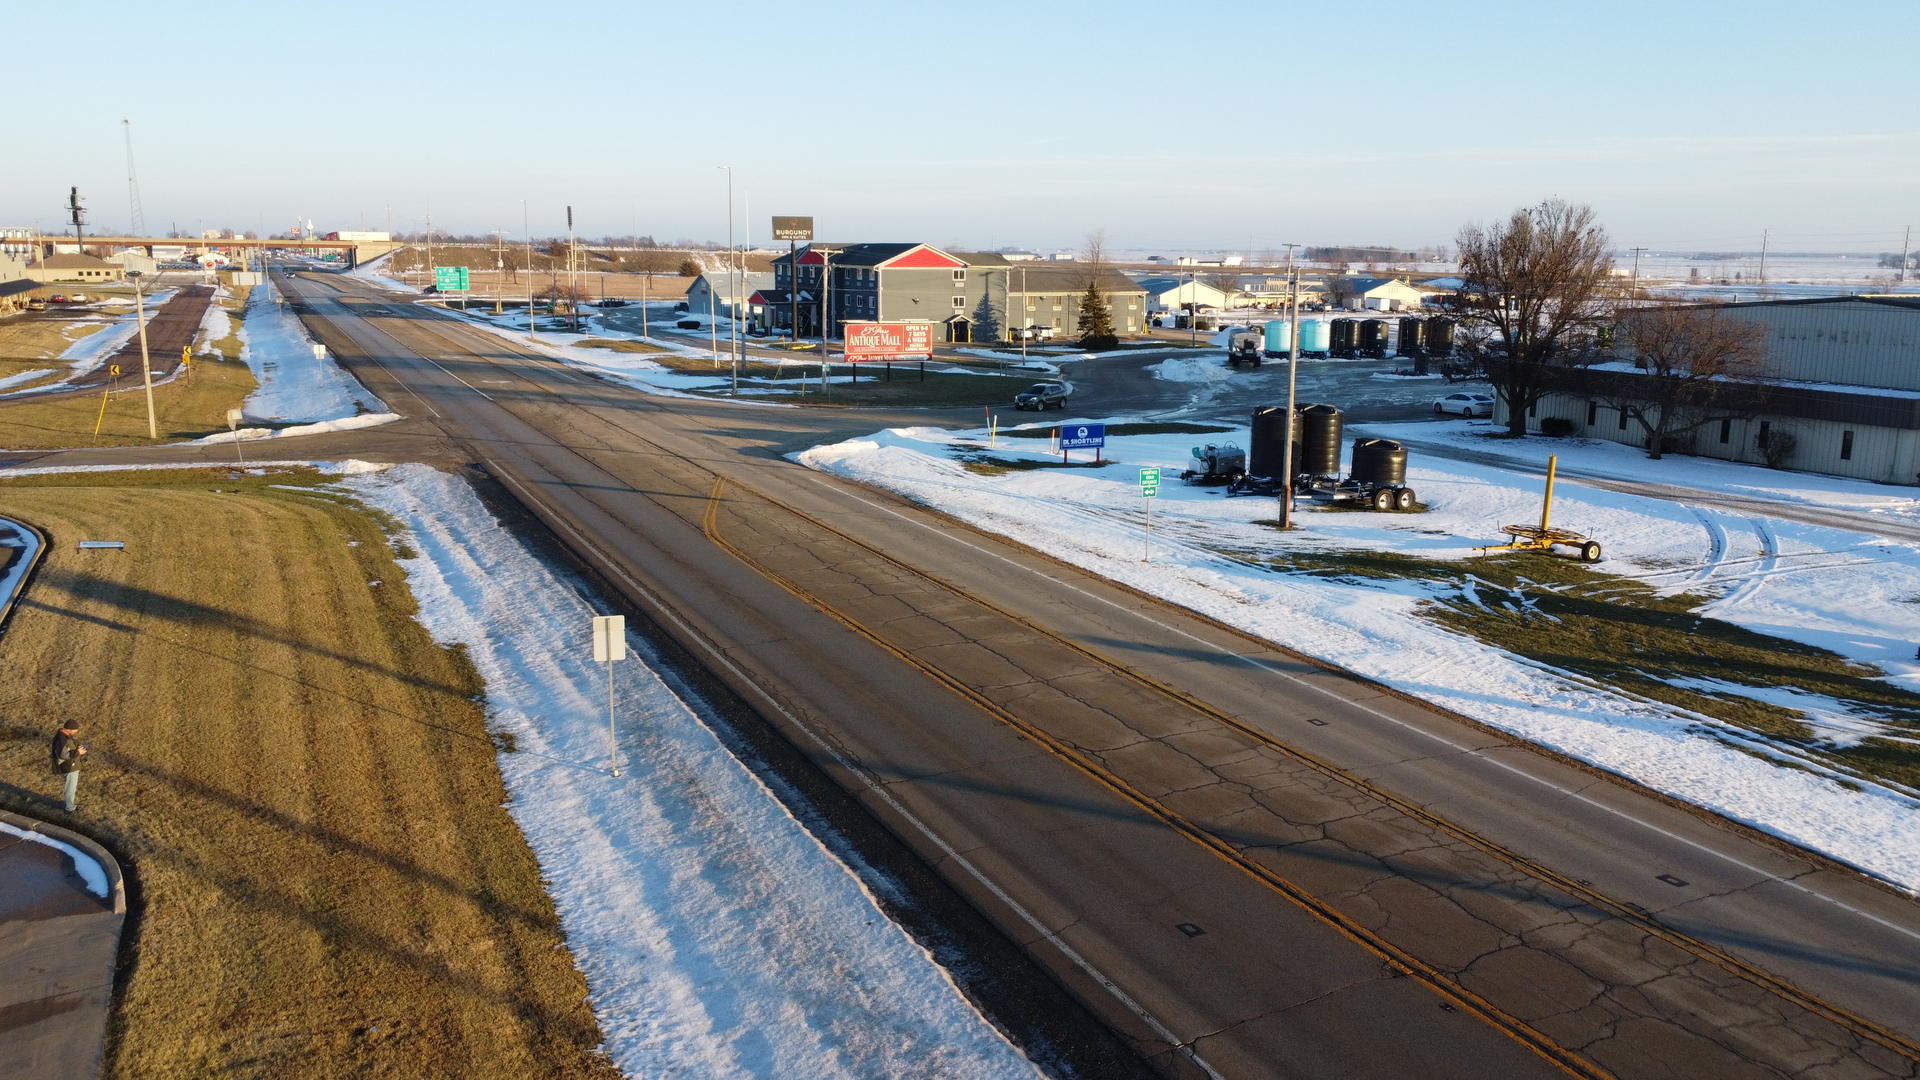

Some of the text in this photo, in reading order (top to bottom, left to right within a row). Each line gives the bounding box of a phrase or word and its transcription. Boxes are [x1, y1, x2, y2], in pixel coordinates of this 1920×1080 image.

[861, 326, 871, 336] El
[849, 334, 901, 347] ANTIQUE MALL
